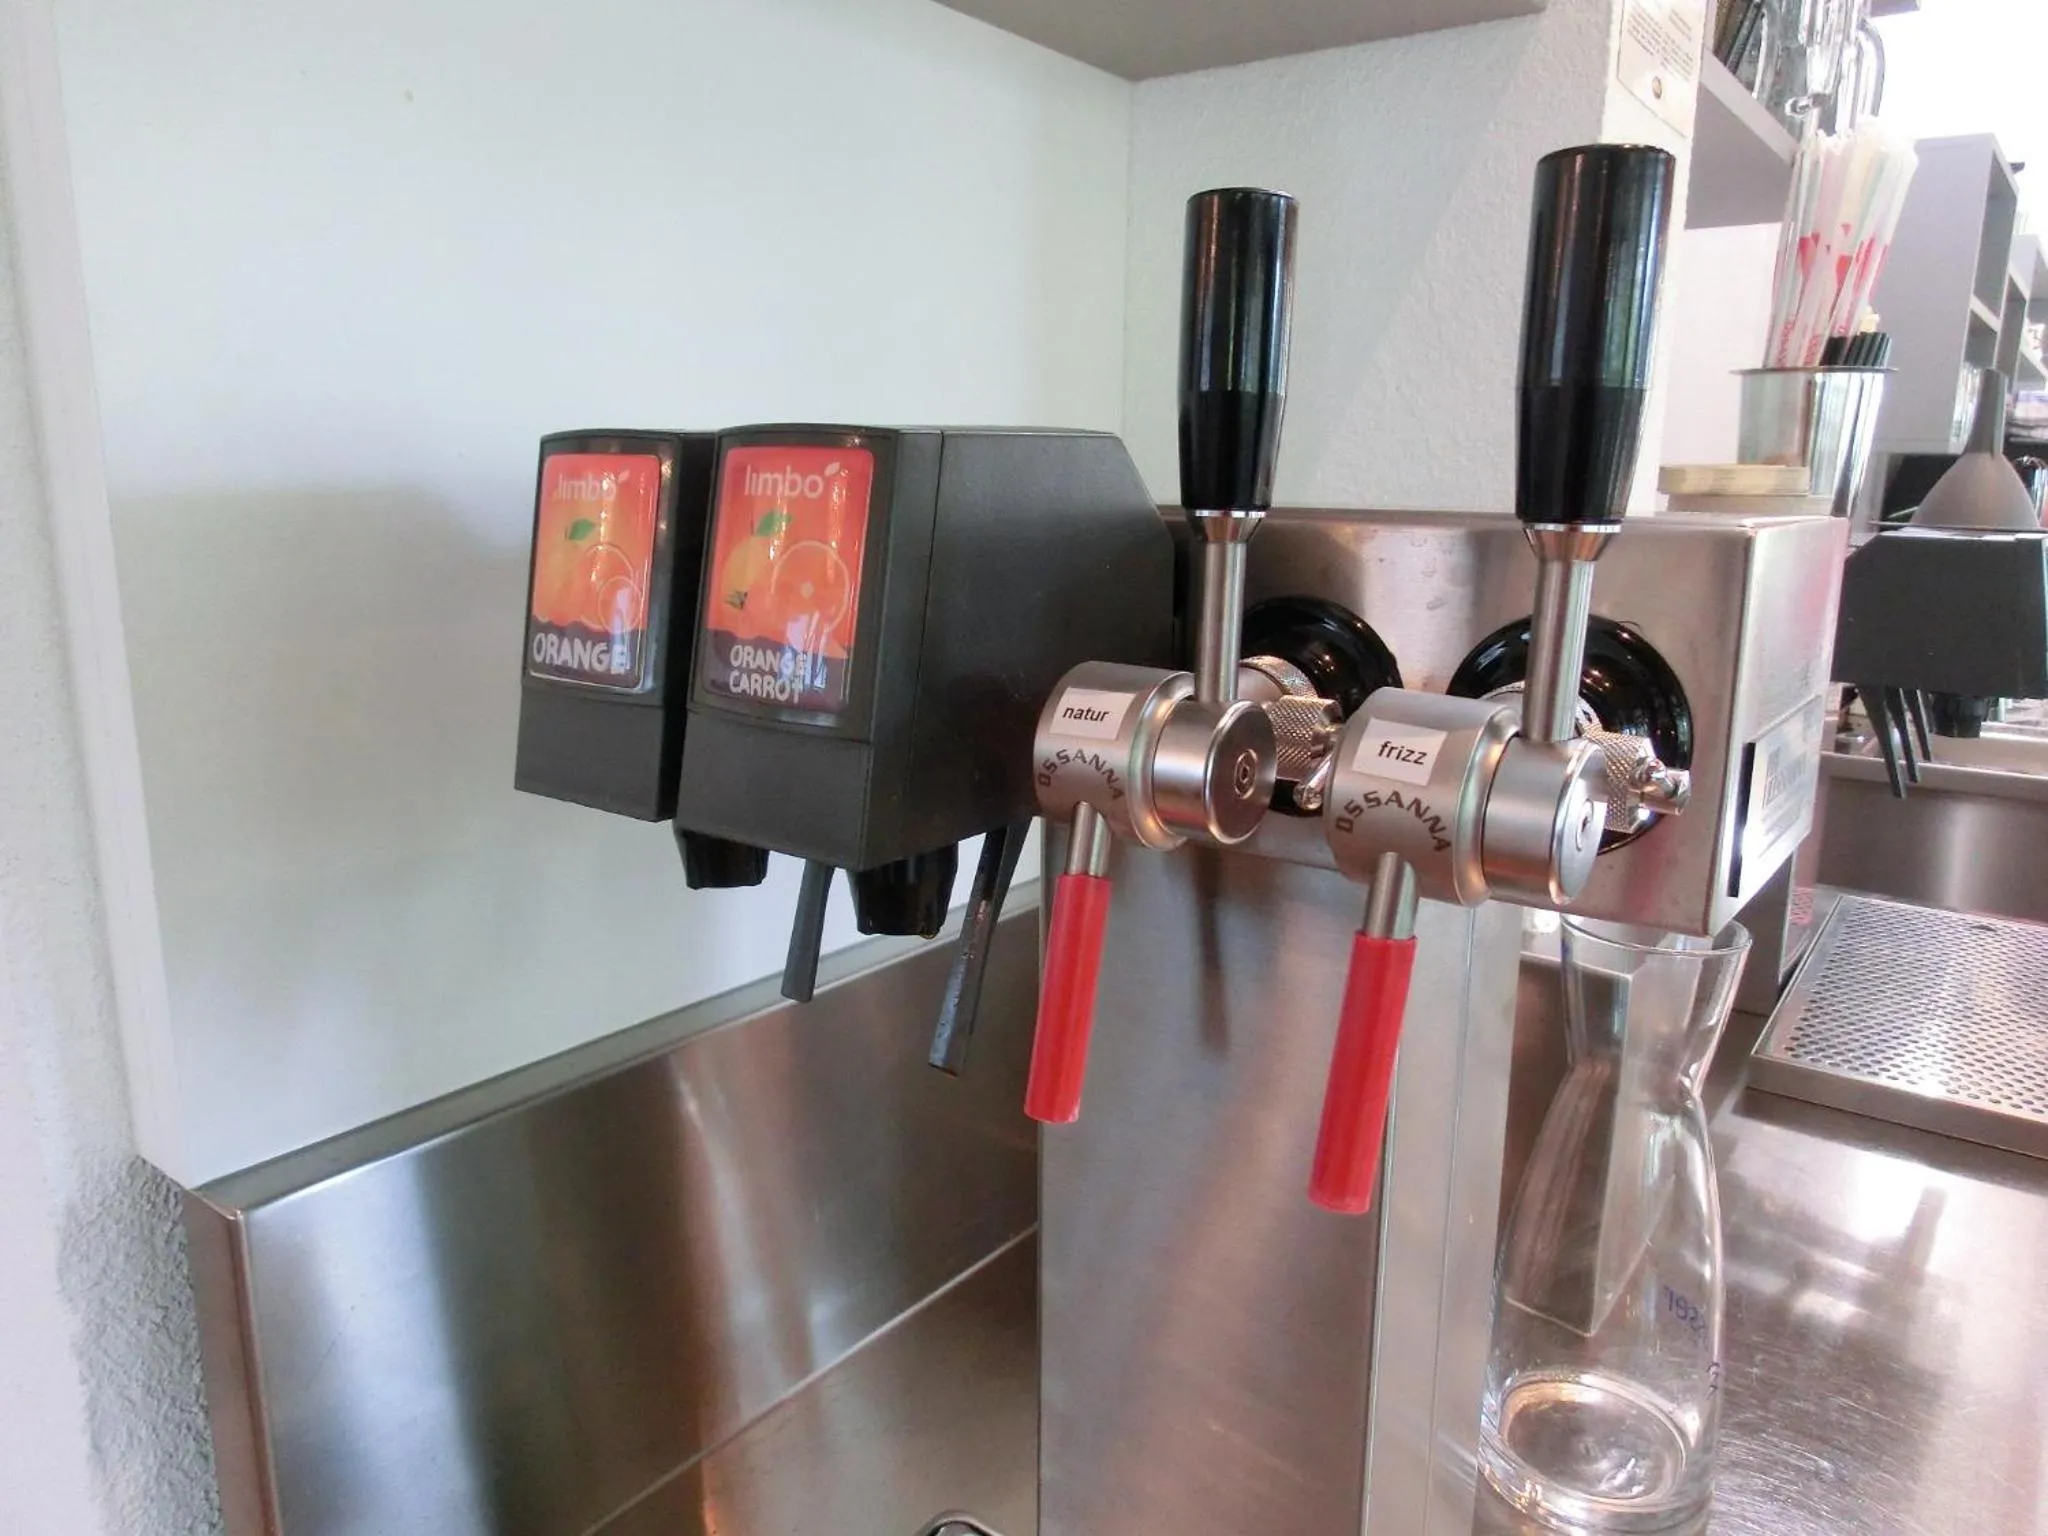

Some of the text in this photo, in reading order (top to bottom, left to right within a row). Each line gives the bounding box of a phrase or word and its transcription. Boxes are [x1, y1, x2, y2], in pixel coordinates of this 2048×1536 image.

[555, 473, 617, 501] limbo
[744, 465, 824, 499] limbo
[532, 633, 630, 675] ORANGE
[729, 644, 809, 677] ORANGE
[728, 671, 804, 704] CARROT
[1062, 706, 1110, 723] natur
[1377, 740, 1429, 766] frizz
